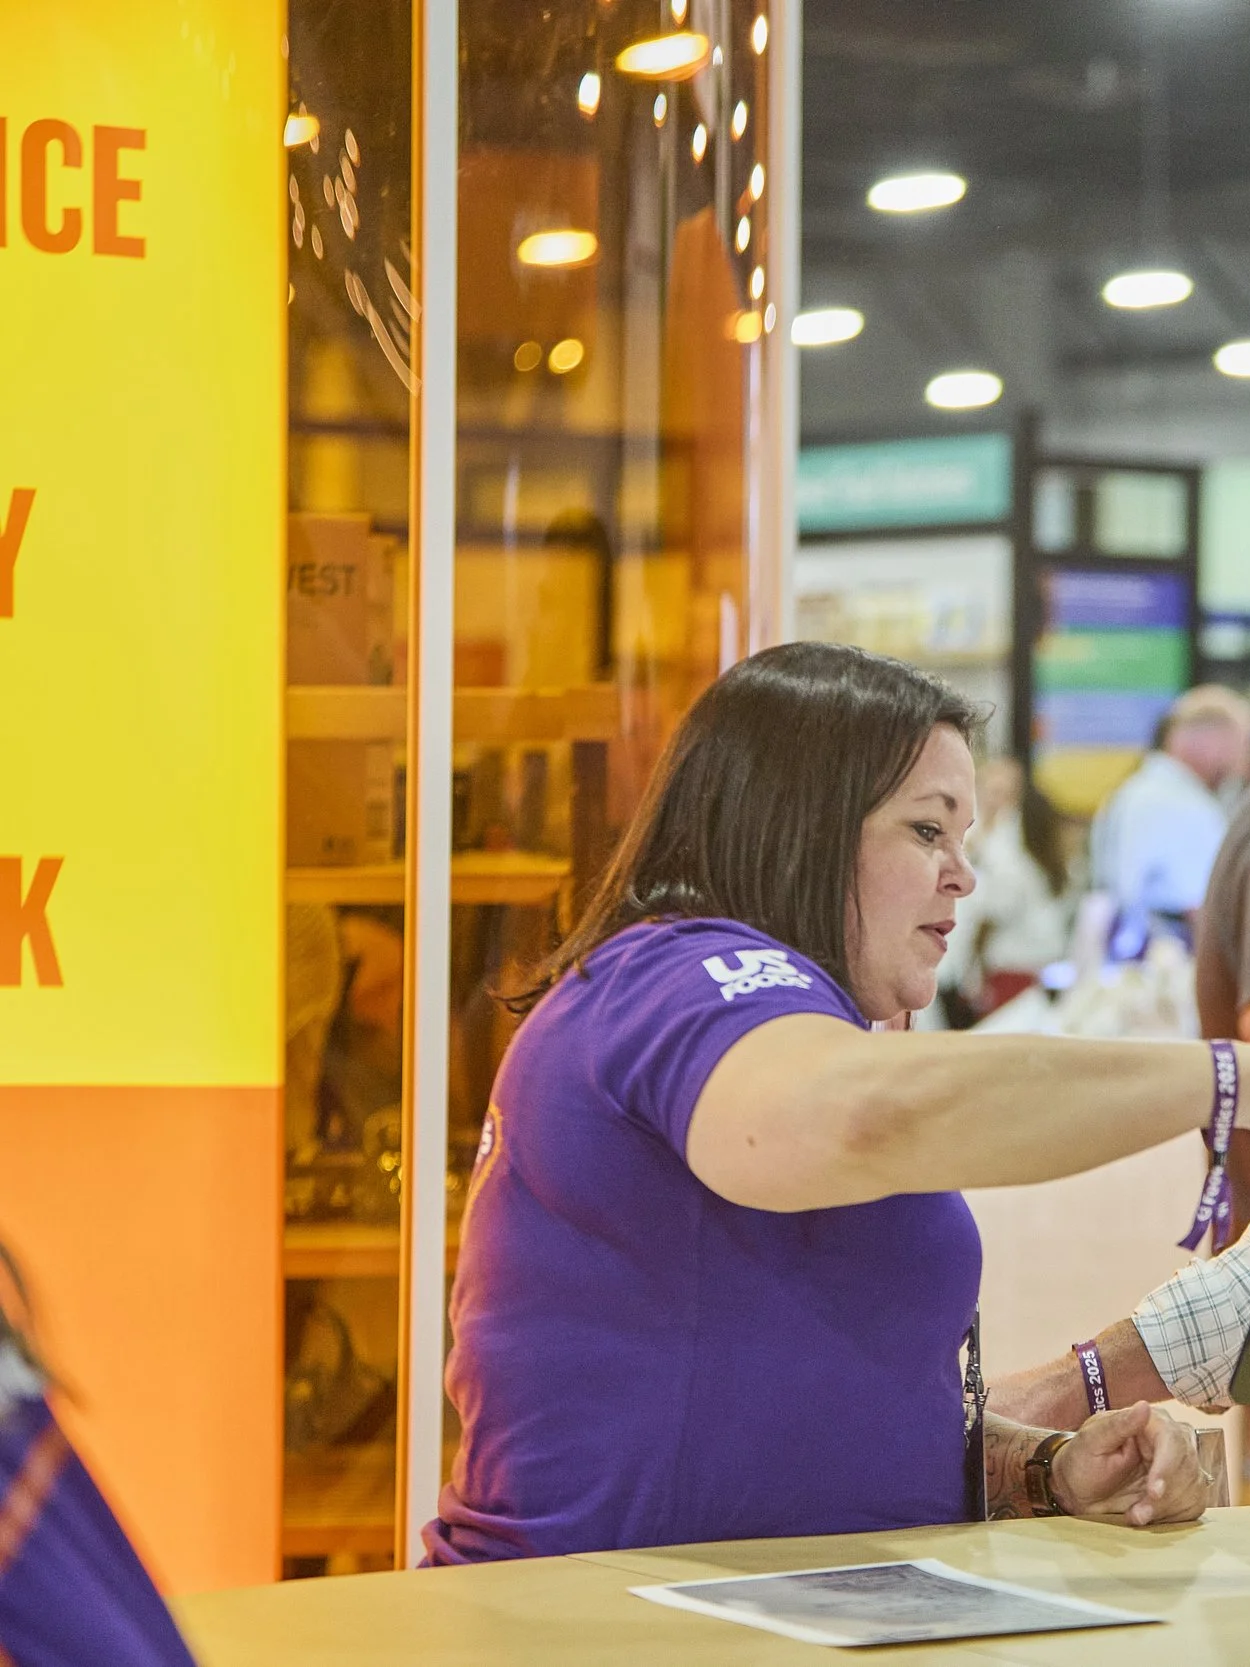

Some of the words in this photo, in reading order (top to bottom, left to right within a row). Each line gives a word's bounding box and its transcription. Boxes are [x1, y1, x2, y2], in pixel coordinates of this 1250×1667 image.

[0, 116, 147, 260] CE
[0, 857, 64, 987] K
[1082, 1350, 1102, 1385] 2025
